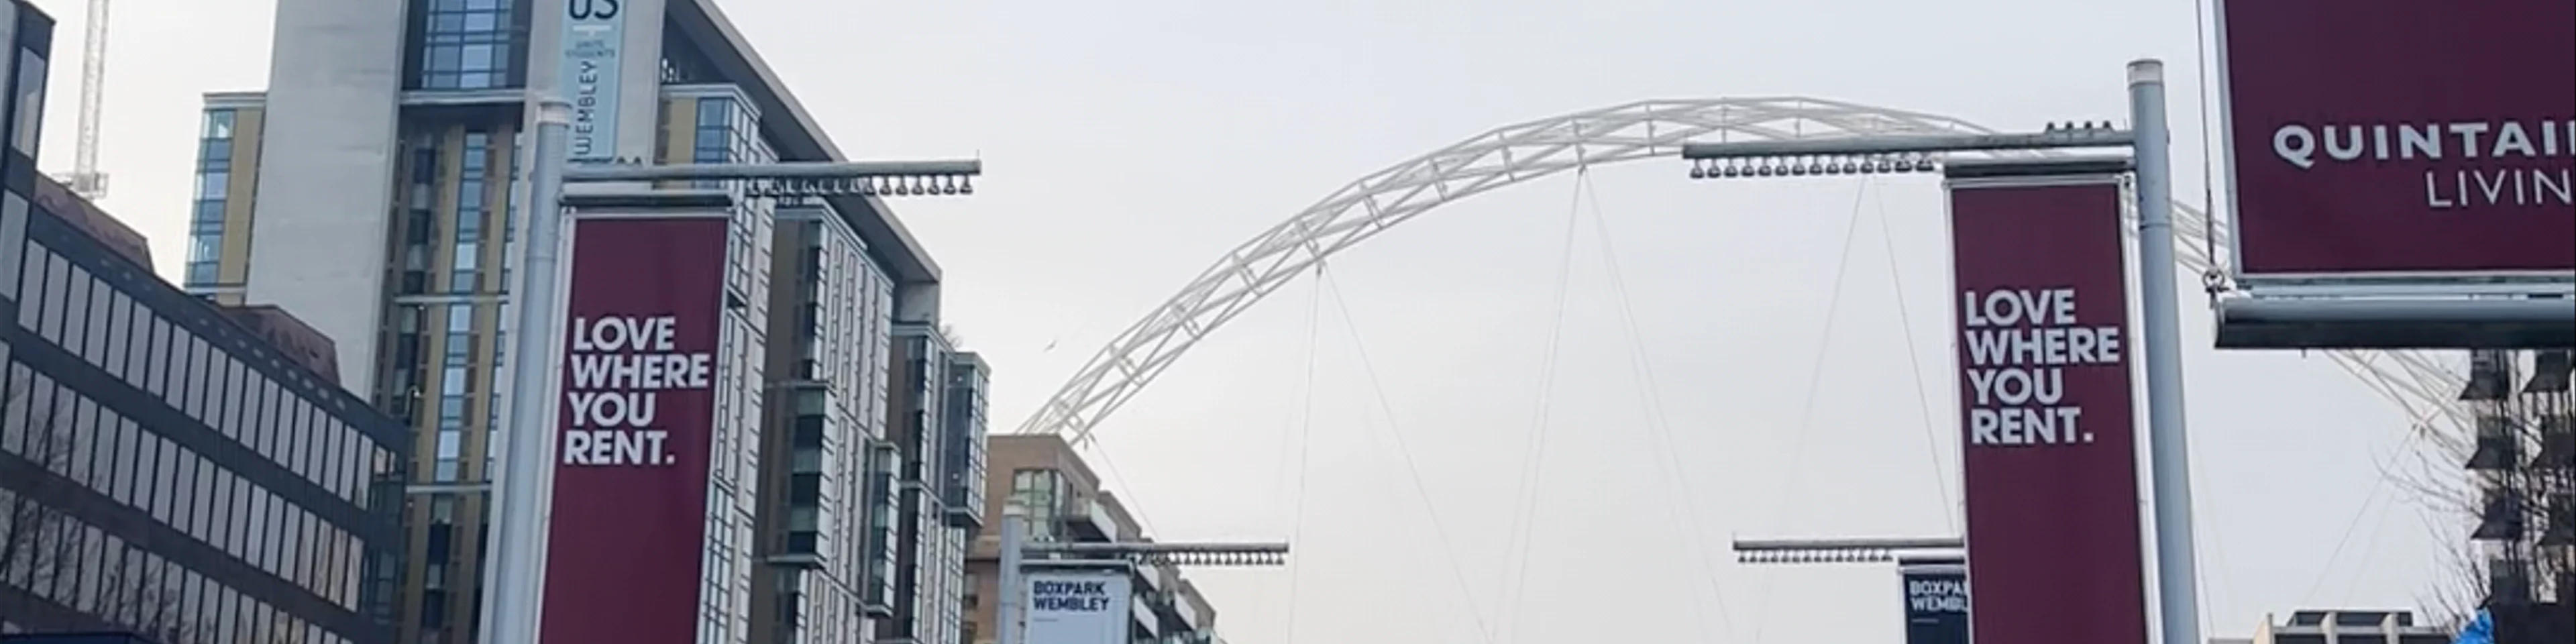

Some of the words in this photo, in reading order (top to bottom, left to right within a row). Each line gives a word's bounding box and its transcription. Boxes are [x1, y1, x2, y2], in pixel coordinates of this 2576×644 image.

[574, 61, 597, 154] WEMBLEY
[2426, 169, 2571, 207] LIVIN
[1965, 289, 2076, 326] LOVE
[573, 316, 676, 351] LOVE
[1966, 327, 2120, 365] WHERE
[571, 354, 710, 388] WHERE
[1967, 368, 2063, 405] YOU
[568, 392, 655, 427] YOU
[1972, 407, 2094, 444] RENT.
[564, 430, 675, 465] RENT.
[1034, 581, 1106, 595] BOXPARK
[1034, 597, 1109, 610] WEMBLEY
